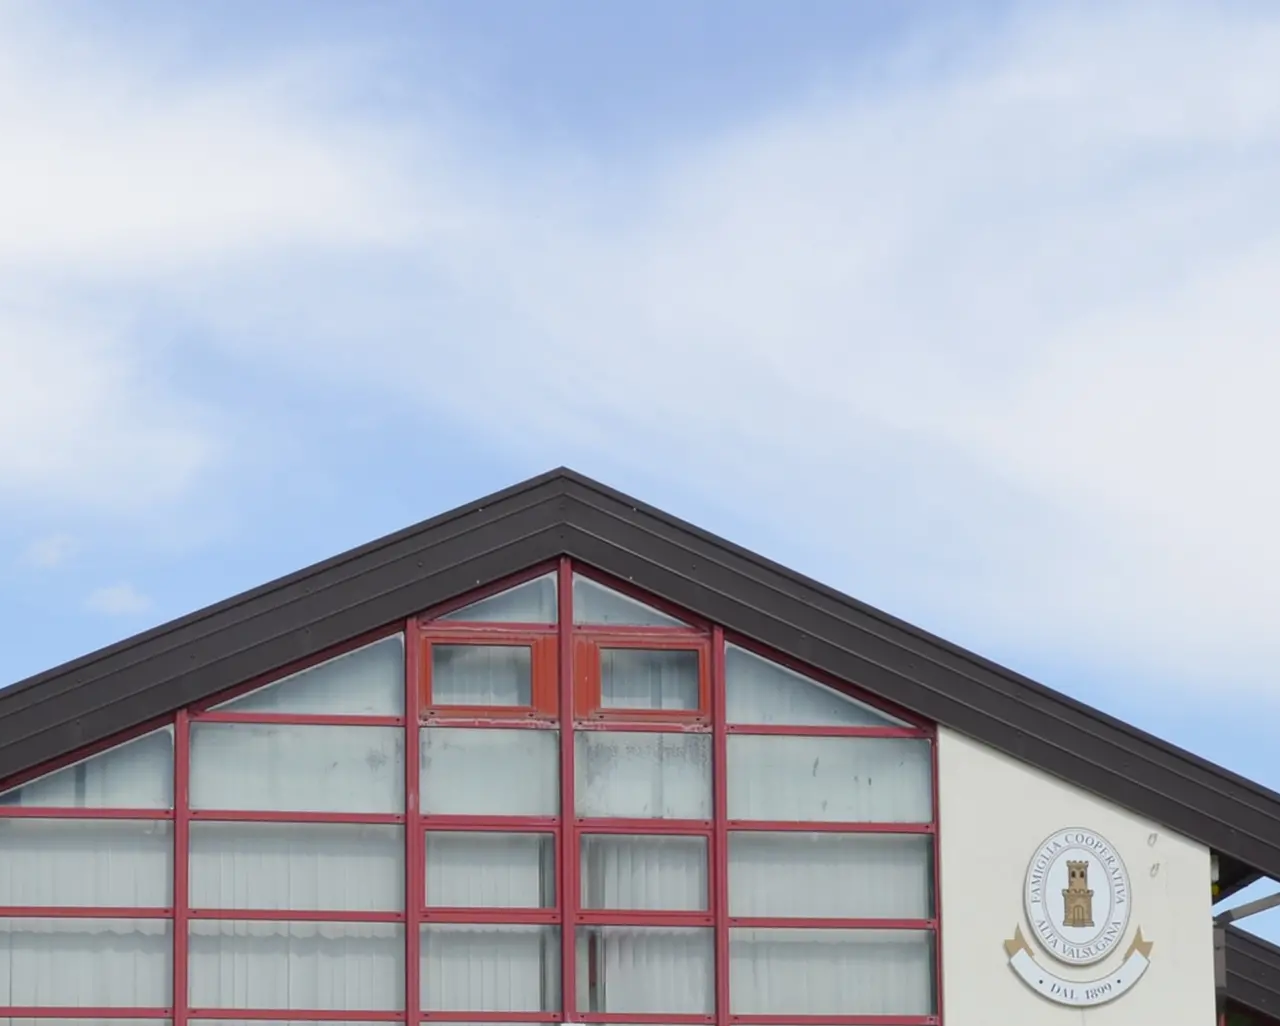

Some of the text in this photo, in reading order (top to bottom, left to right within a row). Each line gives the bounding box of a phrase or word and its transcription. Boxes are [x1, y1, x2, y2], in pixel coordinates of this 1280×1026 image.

[1031, 833, 1126, 904] FAMIGLIA COOPERATIVA
[1037, 918, 1122, 959] ALTA VALSUGANA
[1051, 983, 1112, 1000] DAL 1899
